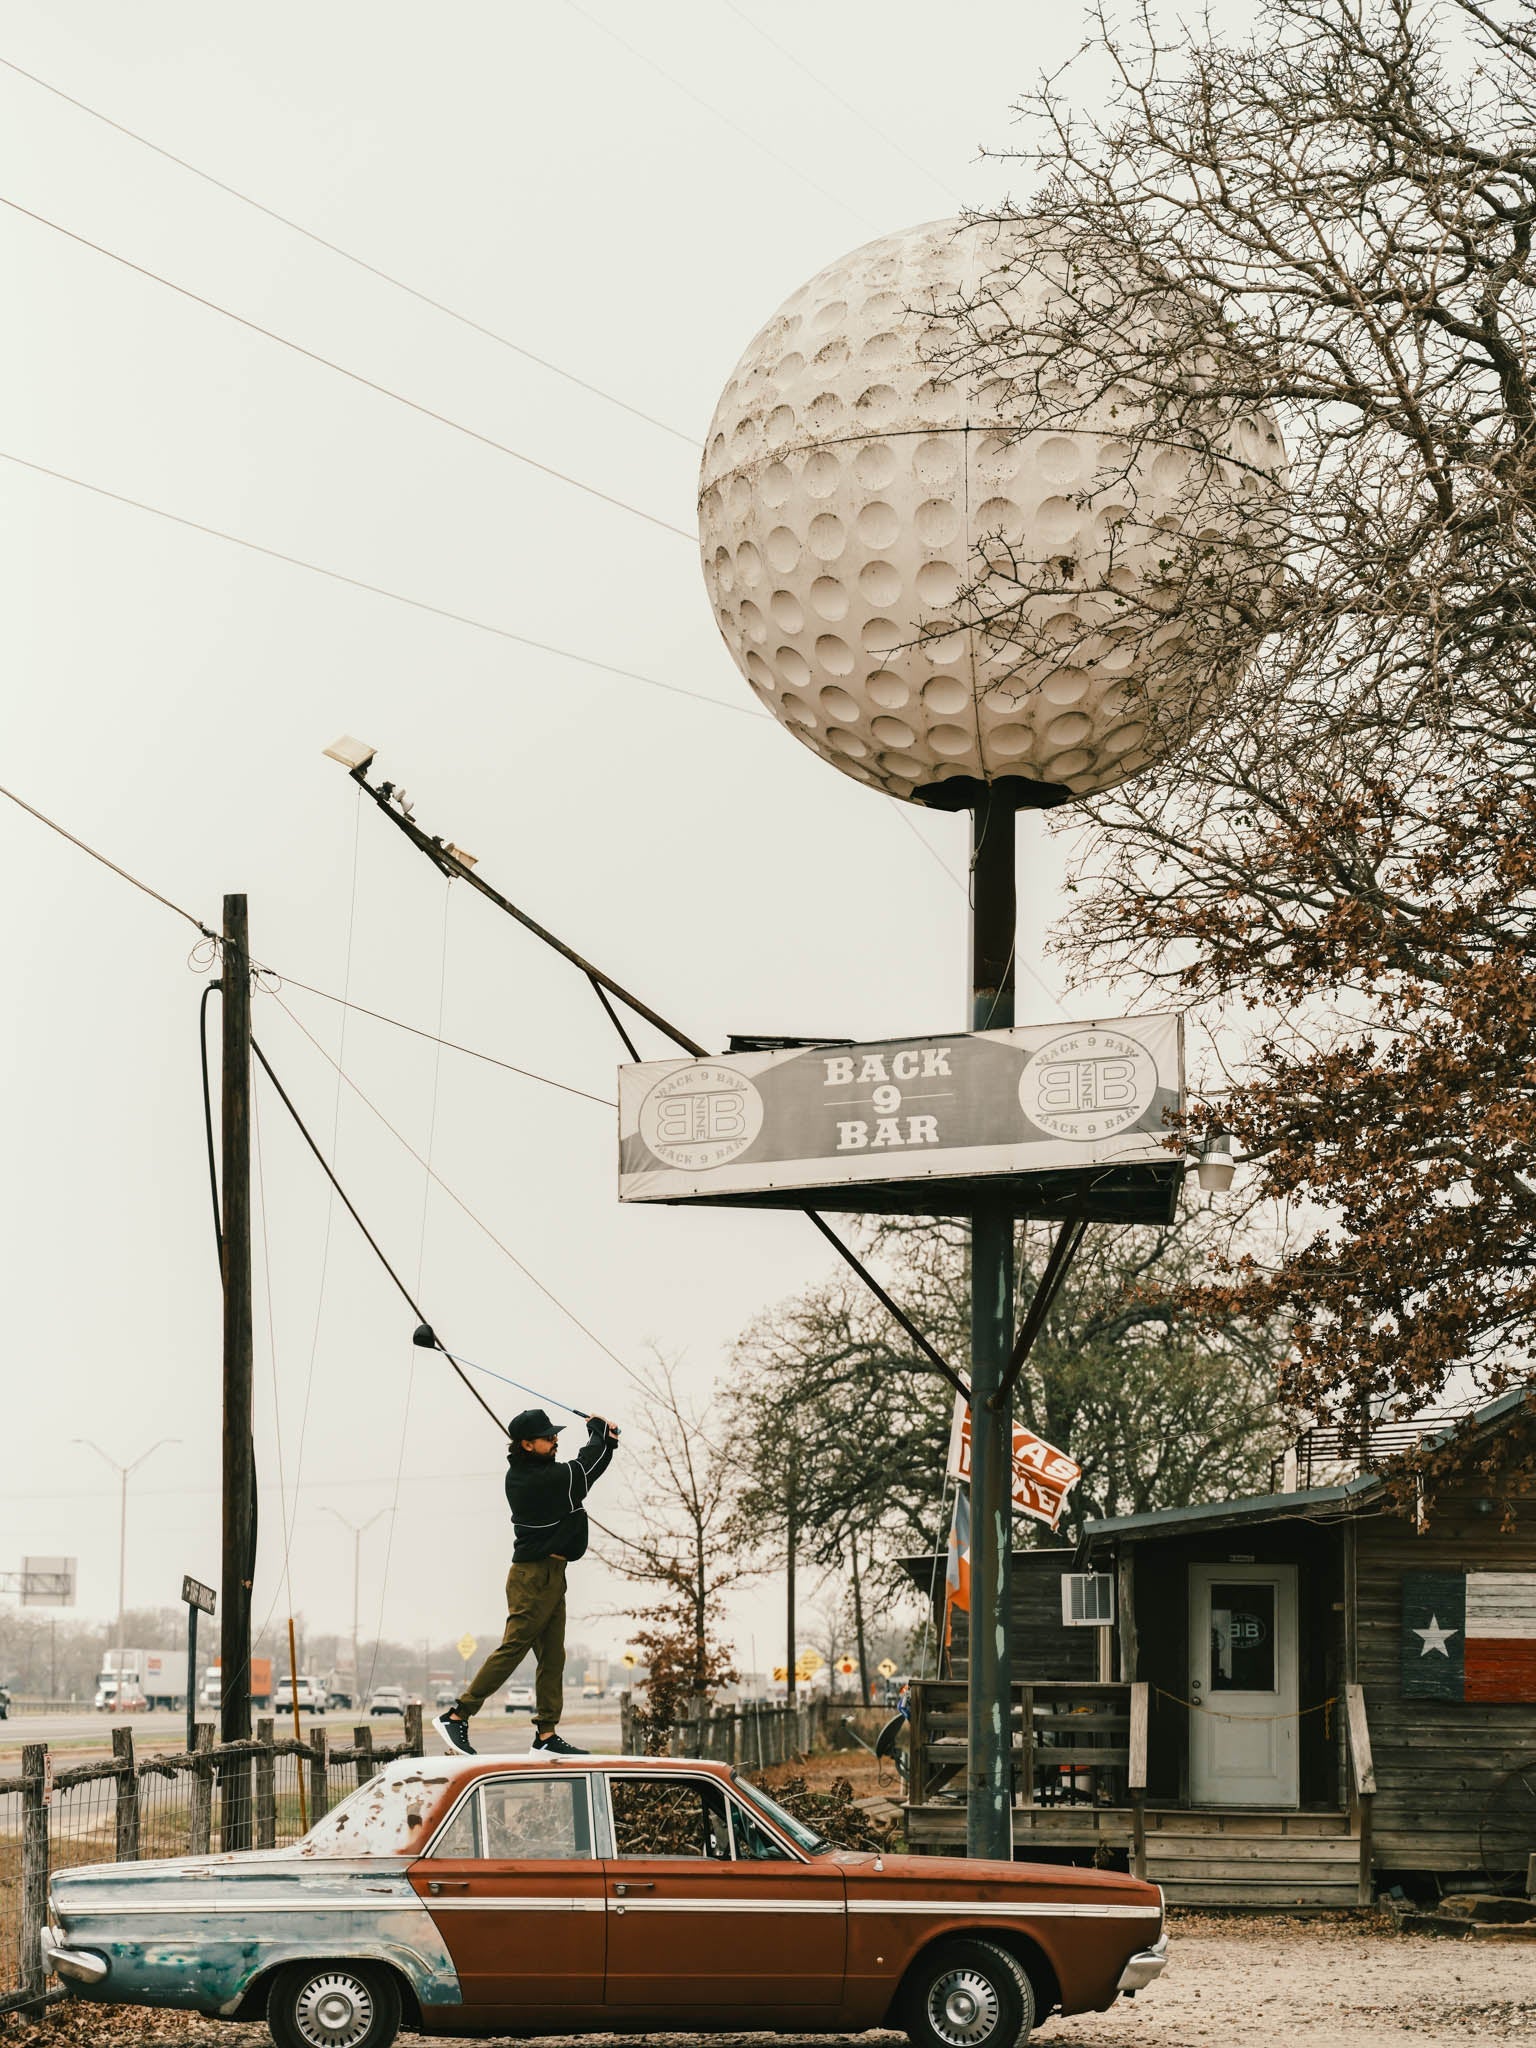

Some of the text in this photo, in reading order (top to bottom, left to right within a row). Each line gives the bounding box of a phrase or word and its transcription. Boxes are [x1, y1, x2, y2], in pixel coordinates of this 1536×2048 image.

[823, 1047, 953, 1086] BACK
[1039, 1036, 1135, 1066] BACK 9 BAR
[871, 1084, 902, 1115] 9
[1081, 1063, 1093, 1109] NINE
[695, 1095, 706, 1140] NINE
[836, 1115, 940, 1150] BAR
[1039, 1109, 1136, 1135] BACK 9 BAR
